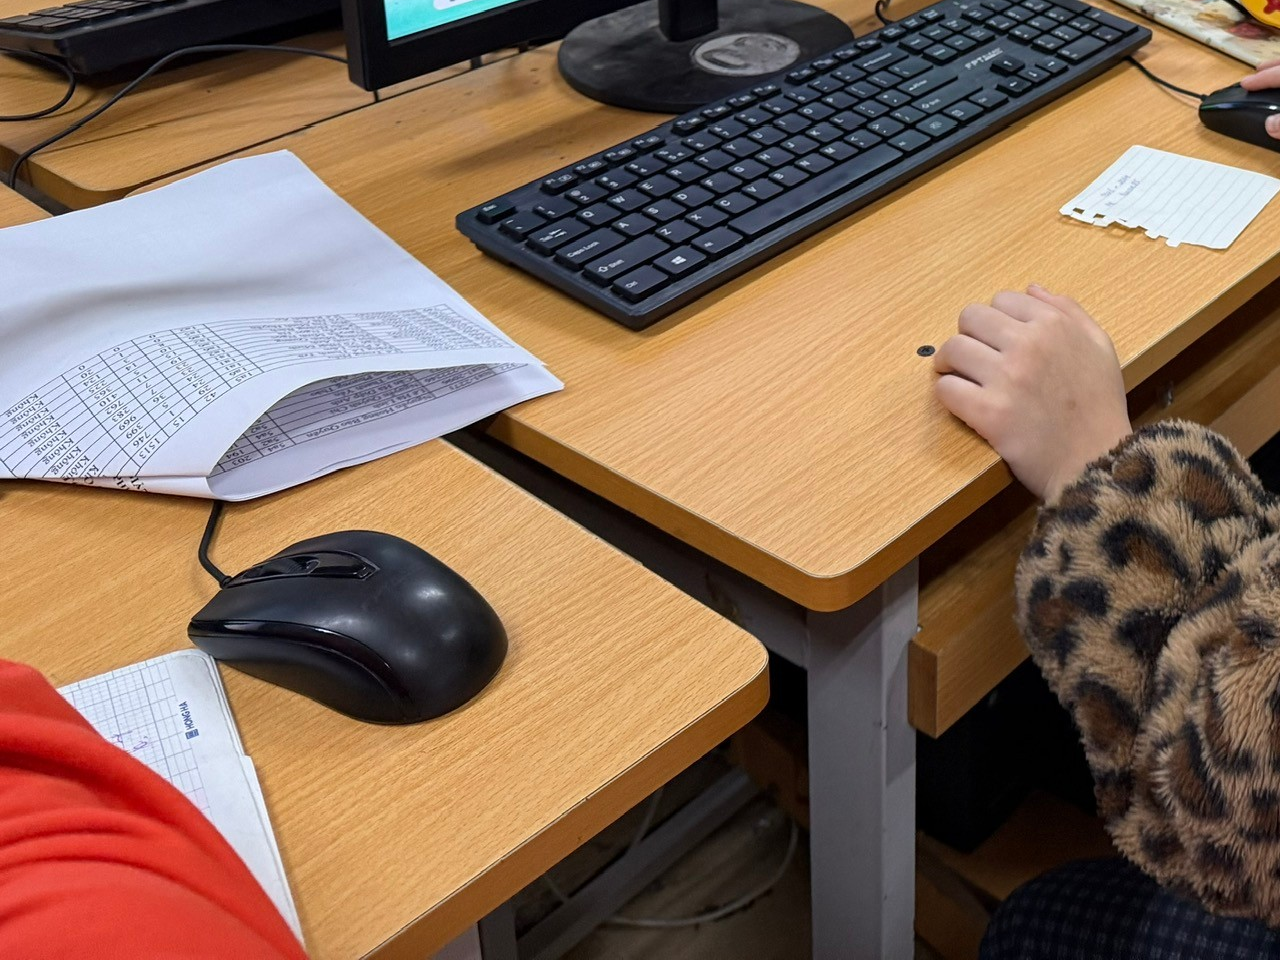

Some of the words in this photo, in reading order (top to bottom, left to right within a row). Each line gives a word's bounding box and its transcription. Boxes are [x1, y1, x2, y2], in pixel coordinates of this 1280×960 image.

[176, 362, 189, 370] 23
[181, 367, 194, 376] 23
[84, 375, 100, 386] 124
[187, 373, 199, 381] 24
[192, 379, 205, 388] 24
[89, 380, 107, 393] 225
[94, 387, 113, 400] 365
[199, 385, 211, 395] 29
[100, 393, 117, 407] 410
[153, 393, 166, 403] 36
[204, 392, 216, 402] 42
[6, 393, 38, 417] Không
[10, 400, 44, 424] Không
[105, 401, 124, 415] 762
[15, 407, 49, 431] Không
[112, 407, 130, 422] 283
[21, 415, 54, 439] Không
[119, 415, 136, 430] 969
[173, 417, 184, 427] 15
[28, 422, 61, 447] Không
[126, 423, 143, 439] 399
[34, 430, 67, 456] Không
[133, 432, 151, 447] 746
[42, 438, 74, 465] Không
[139, 438, 160, 458] 1513
[51, 446, 82, 475] Không
[232, 455, 252, 466] 203
